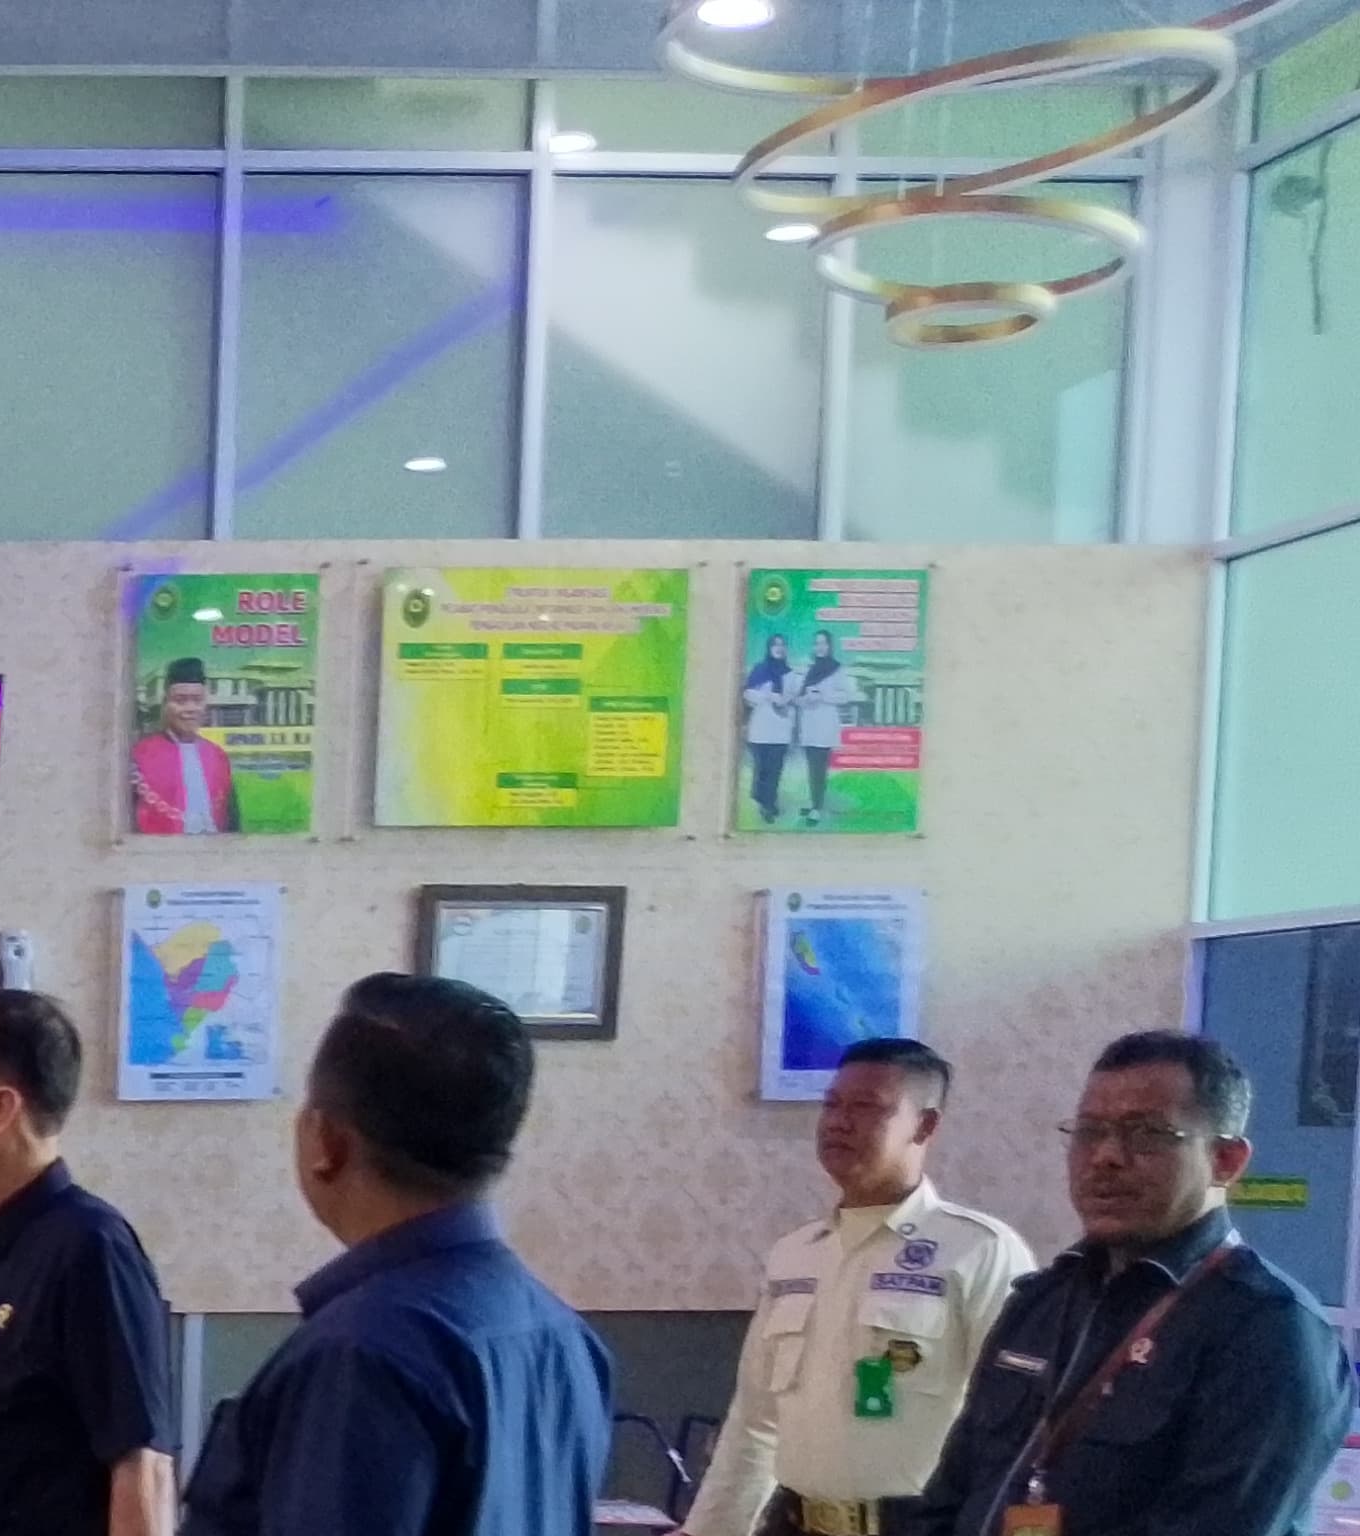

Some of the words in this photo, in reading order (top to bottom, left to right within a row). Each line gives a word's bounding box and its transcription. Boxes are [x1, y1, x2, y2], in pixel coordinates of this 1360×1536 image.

[237, 590, 306, 614] ROLE
[211, 623, 305, 647] MODEL
[875, 1275, 944, 1292] SATPAM
